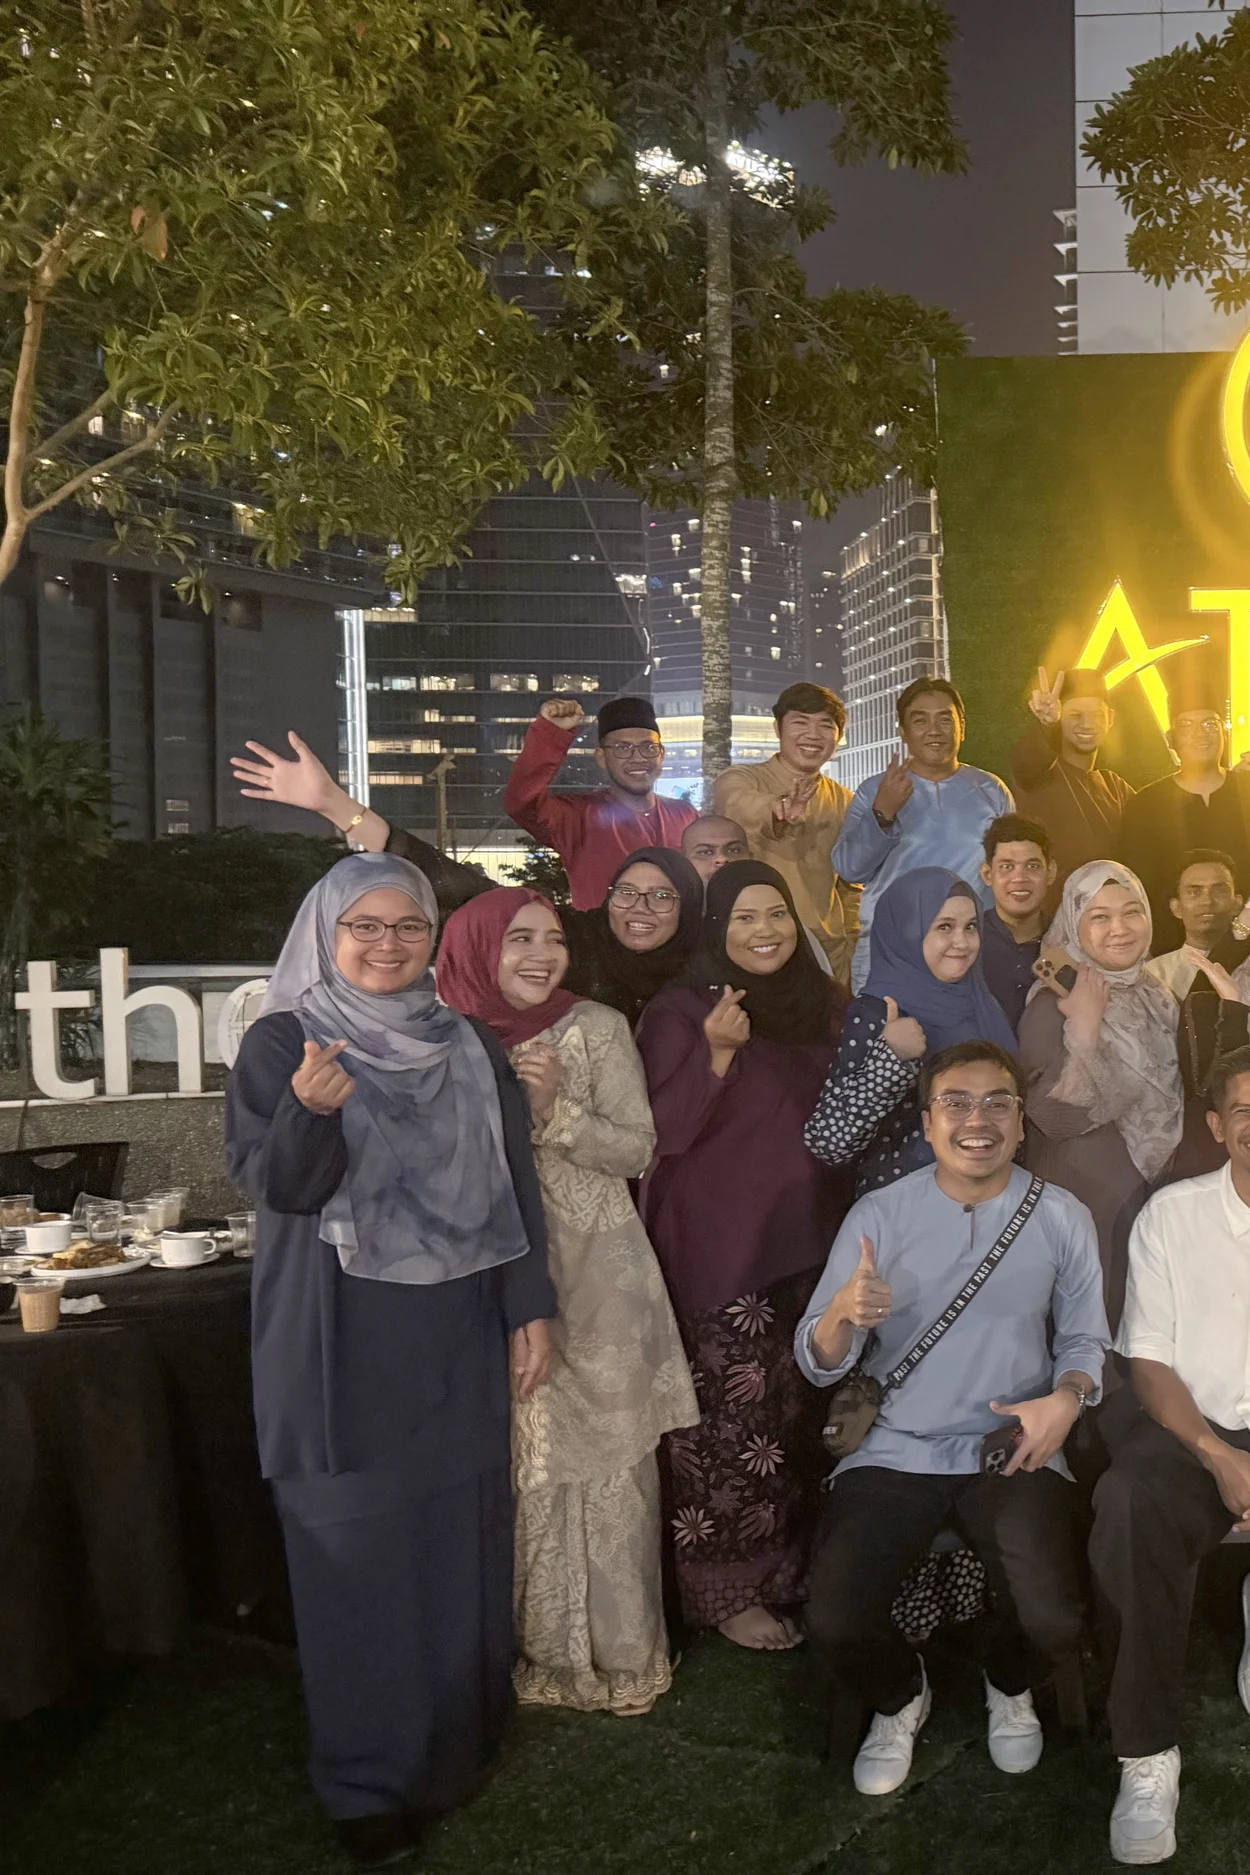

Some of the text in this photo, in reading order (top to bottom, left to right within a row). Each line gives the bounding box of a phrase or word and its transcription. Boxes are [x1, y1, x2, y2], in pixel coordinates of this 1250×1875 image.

[893, 1362, 911, 1381] PAST
[908, 1347, 924, 1363] THE
[920, 1319, 949, 1349] FUTURE
[945, 1309, 957, 1320] IS
[953, 1299, 966, 1310] IN
[960, 1282, 978, 1299] THE
[973, 1261, 993, 1283] PAST
[989, 1244, 1005, 1261] THE
[1000, 1213, 1026, 1245] FUTURE
[1020, 1203, 1032, 1214] IS
[1027, 1193, 1038, 1204] IN
